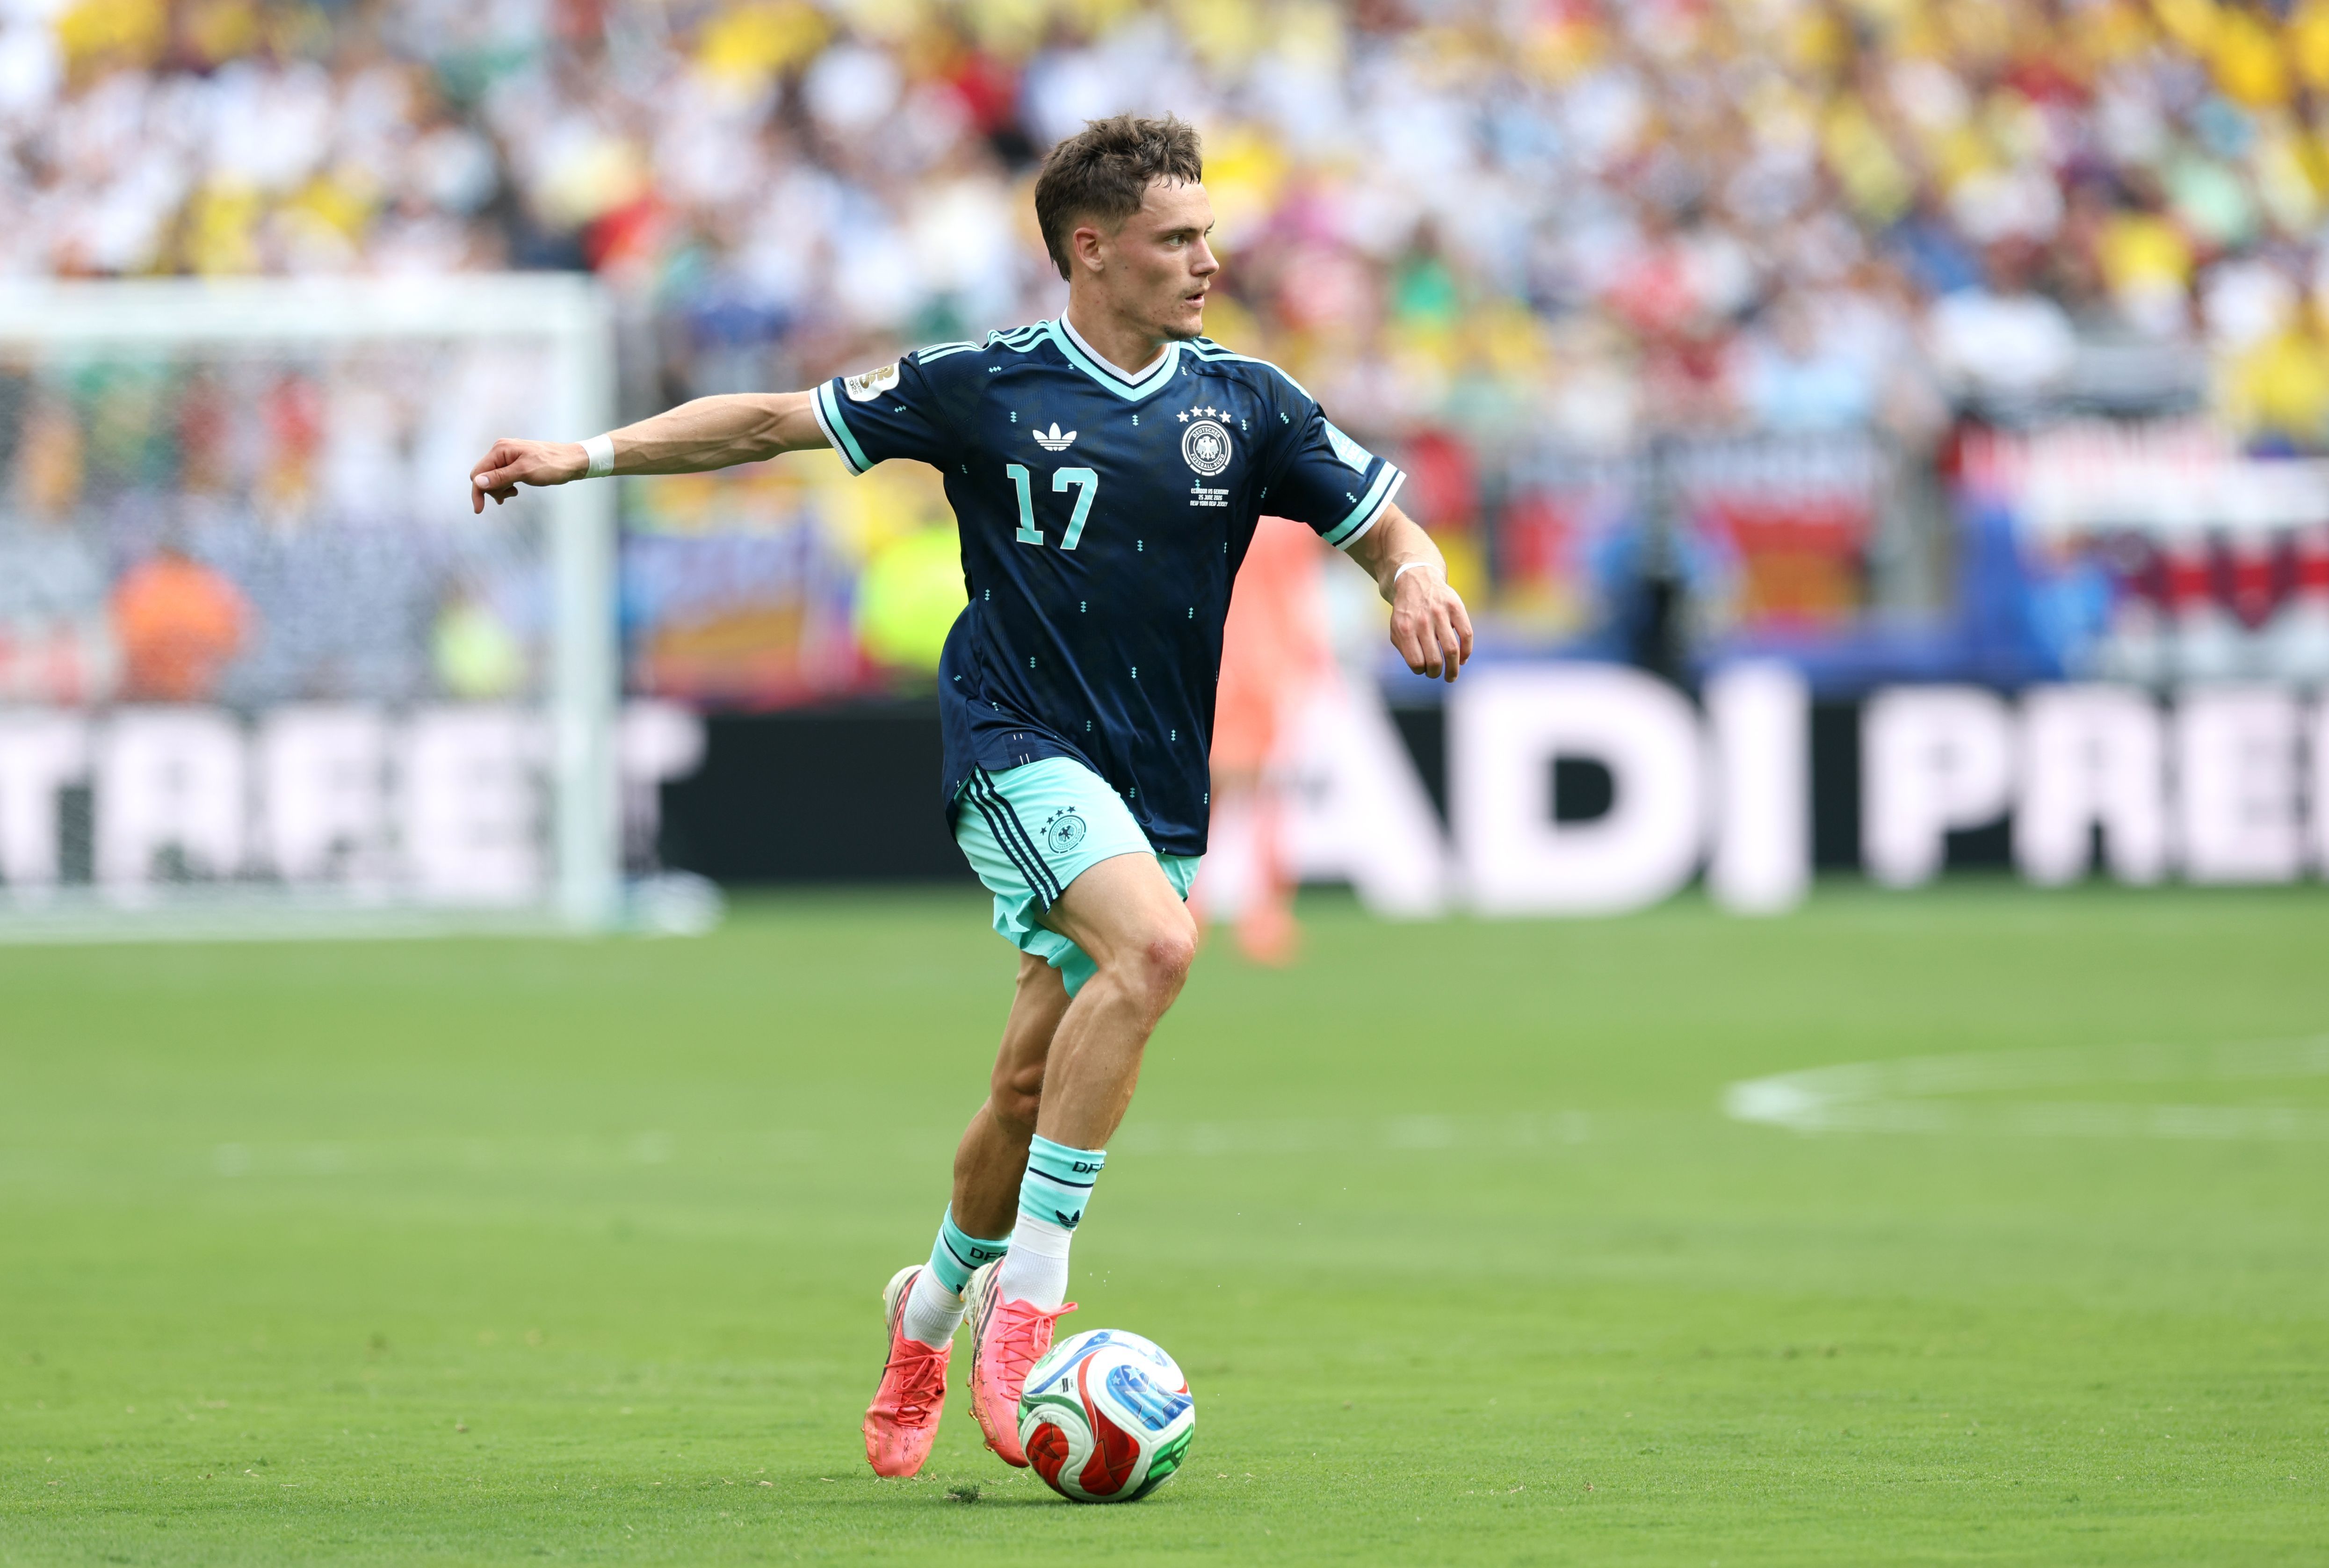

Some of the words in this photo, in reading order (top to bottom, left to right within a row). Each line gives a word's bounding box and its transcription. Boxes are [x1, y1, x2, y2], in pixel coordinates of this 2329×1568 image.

[1193, 428, 1221, 438] DEUTSCHER
[1191, 453, 1224, 469] FUSSBALL-BUND
[1006, 464, 1098, 550] 17
[1864, 683, 2329, 884] PRE
[1053, 820, 1072, 836] DEUTSCHER
